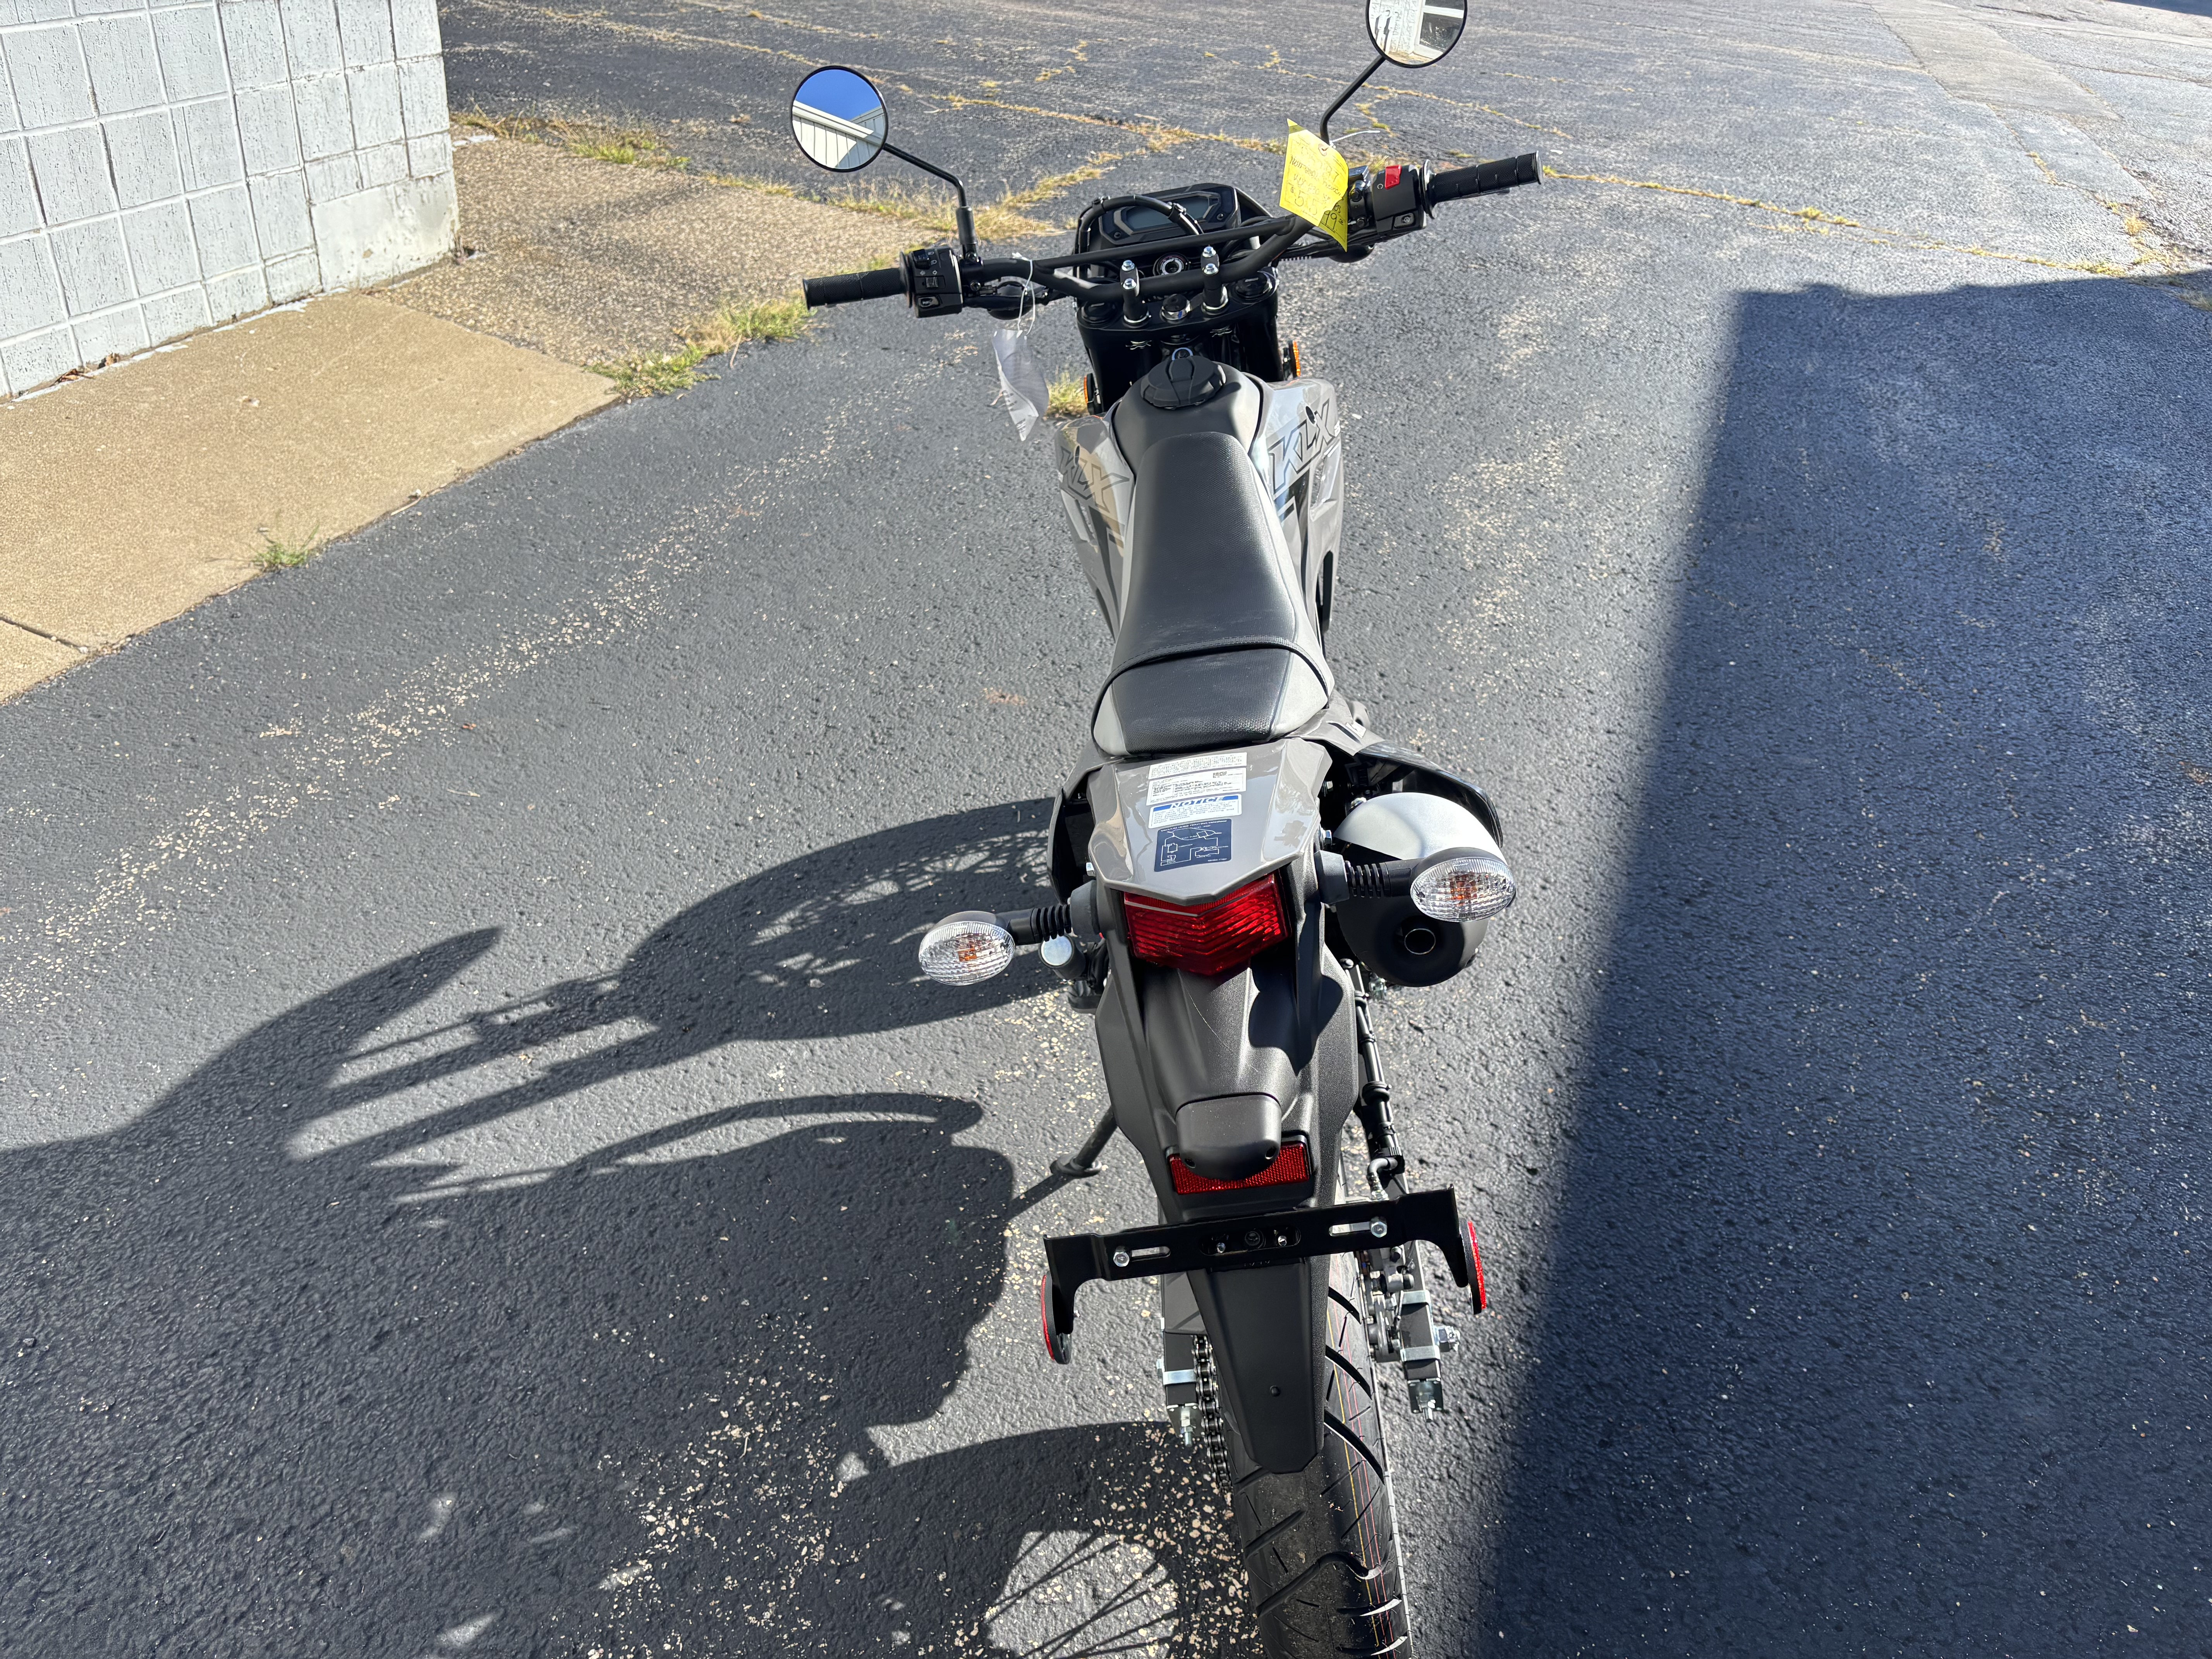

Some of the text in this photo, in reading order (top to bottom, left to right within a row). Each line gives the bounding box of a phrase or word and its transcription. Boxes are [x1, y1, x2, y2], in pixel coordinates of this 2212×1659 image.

[1059, 446, 1130, 513] KLX
[1267, 398, 1336, 494] KLX
[1170, 797, 1224, 809] NOTICE
